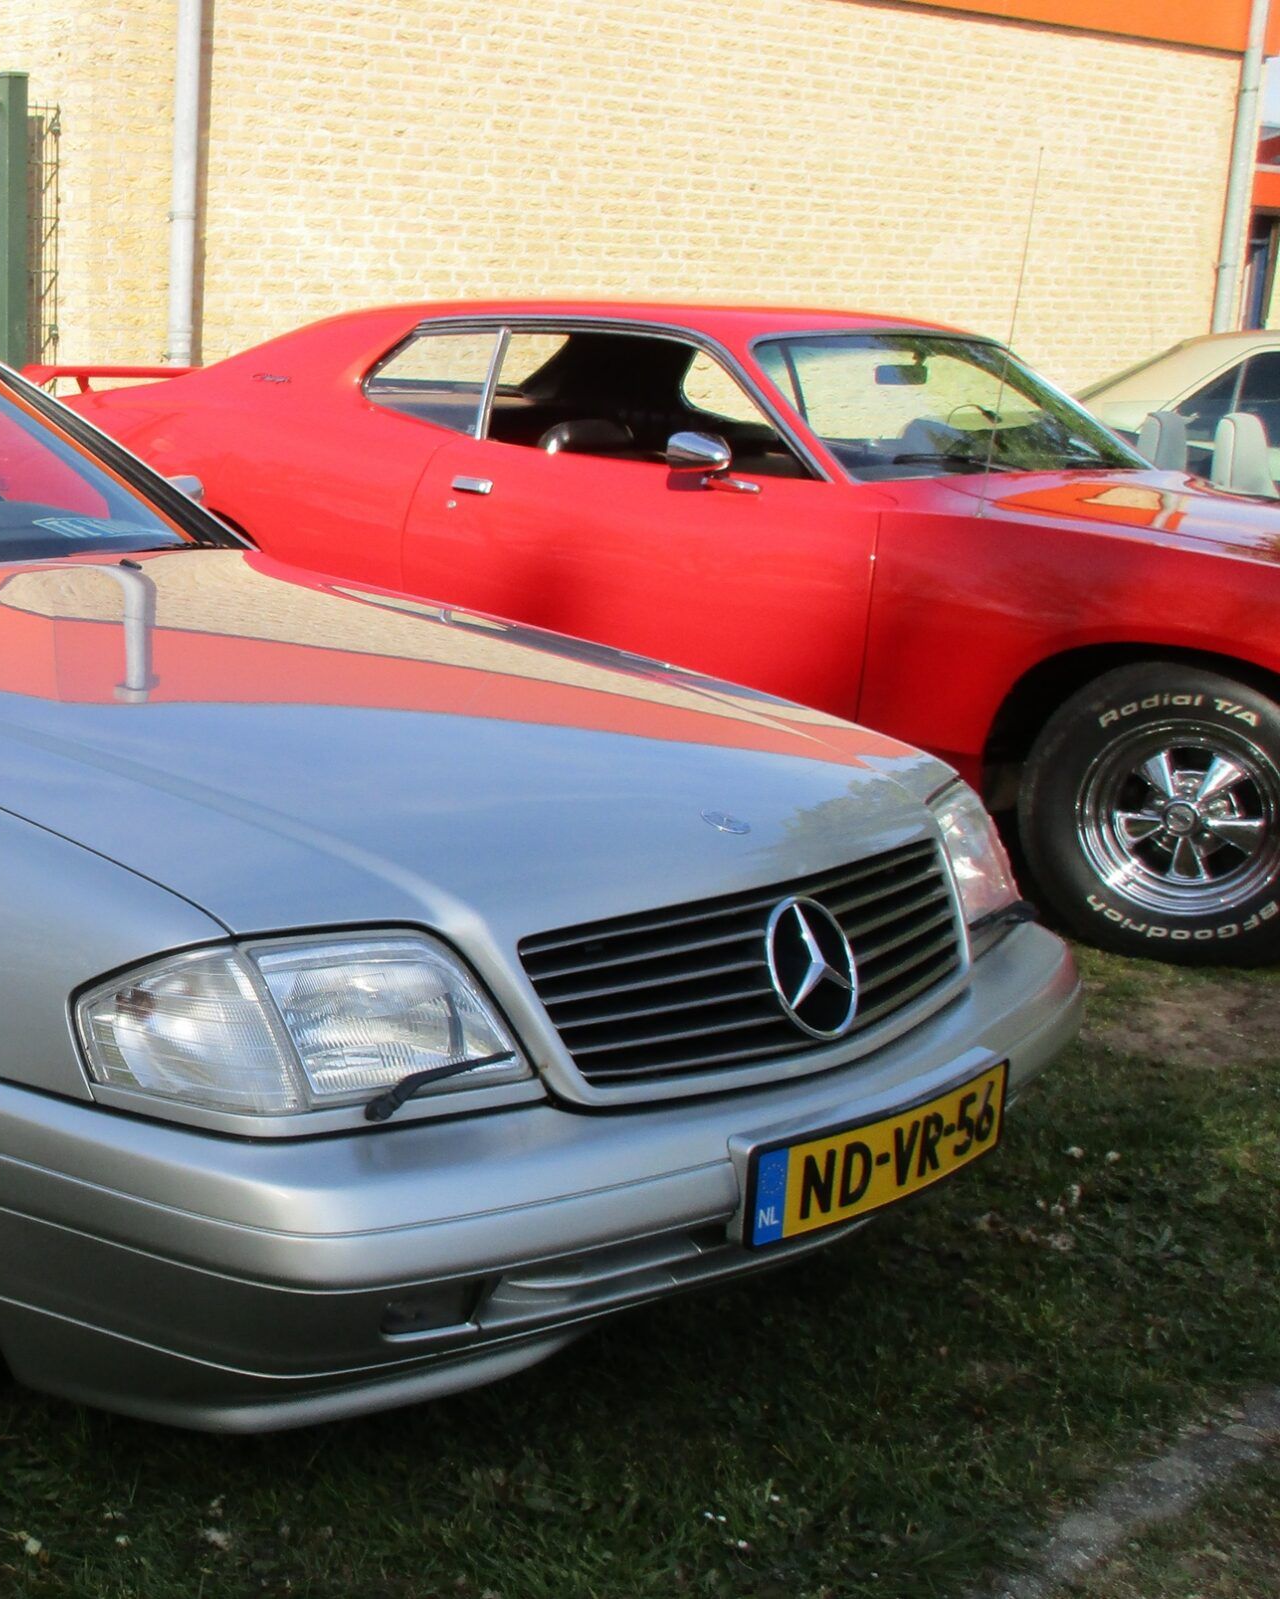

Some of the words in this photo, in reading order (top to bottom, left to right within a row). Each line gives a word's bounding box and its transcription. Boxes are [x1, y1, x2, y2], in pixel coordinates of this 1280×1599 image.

[1098, 694, 1204, 728] Radial
[1214, 698, 1261, 727] T/A
[800, 1081, 995, 1220] ND-VR-56
[758, 1206, 780, 1229] NL
